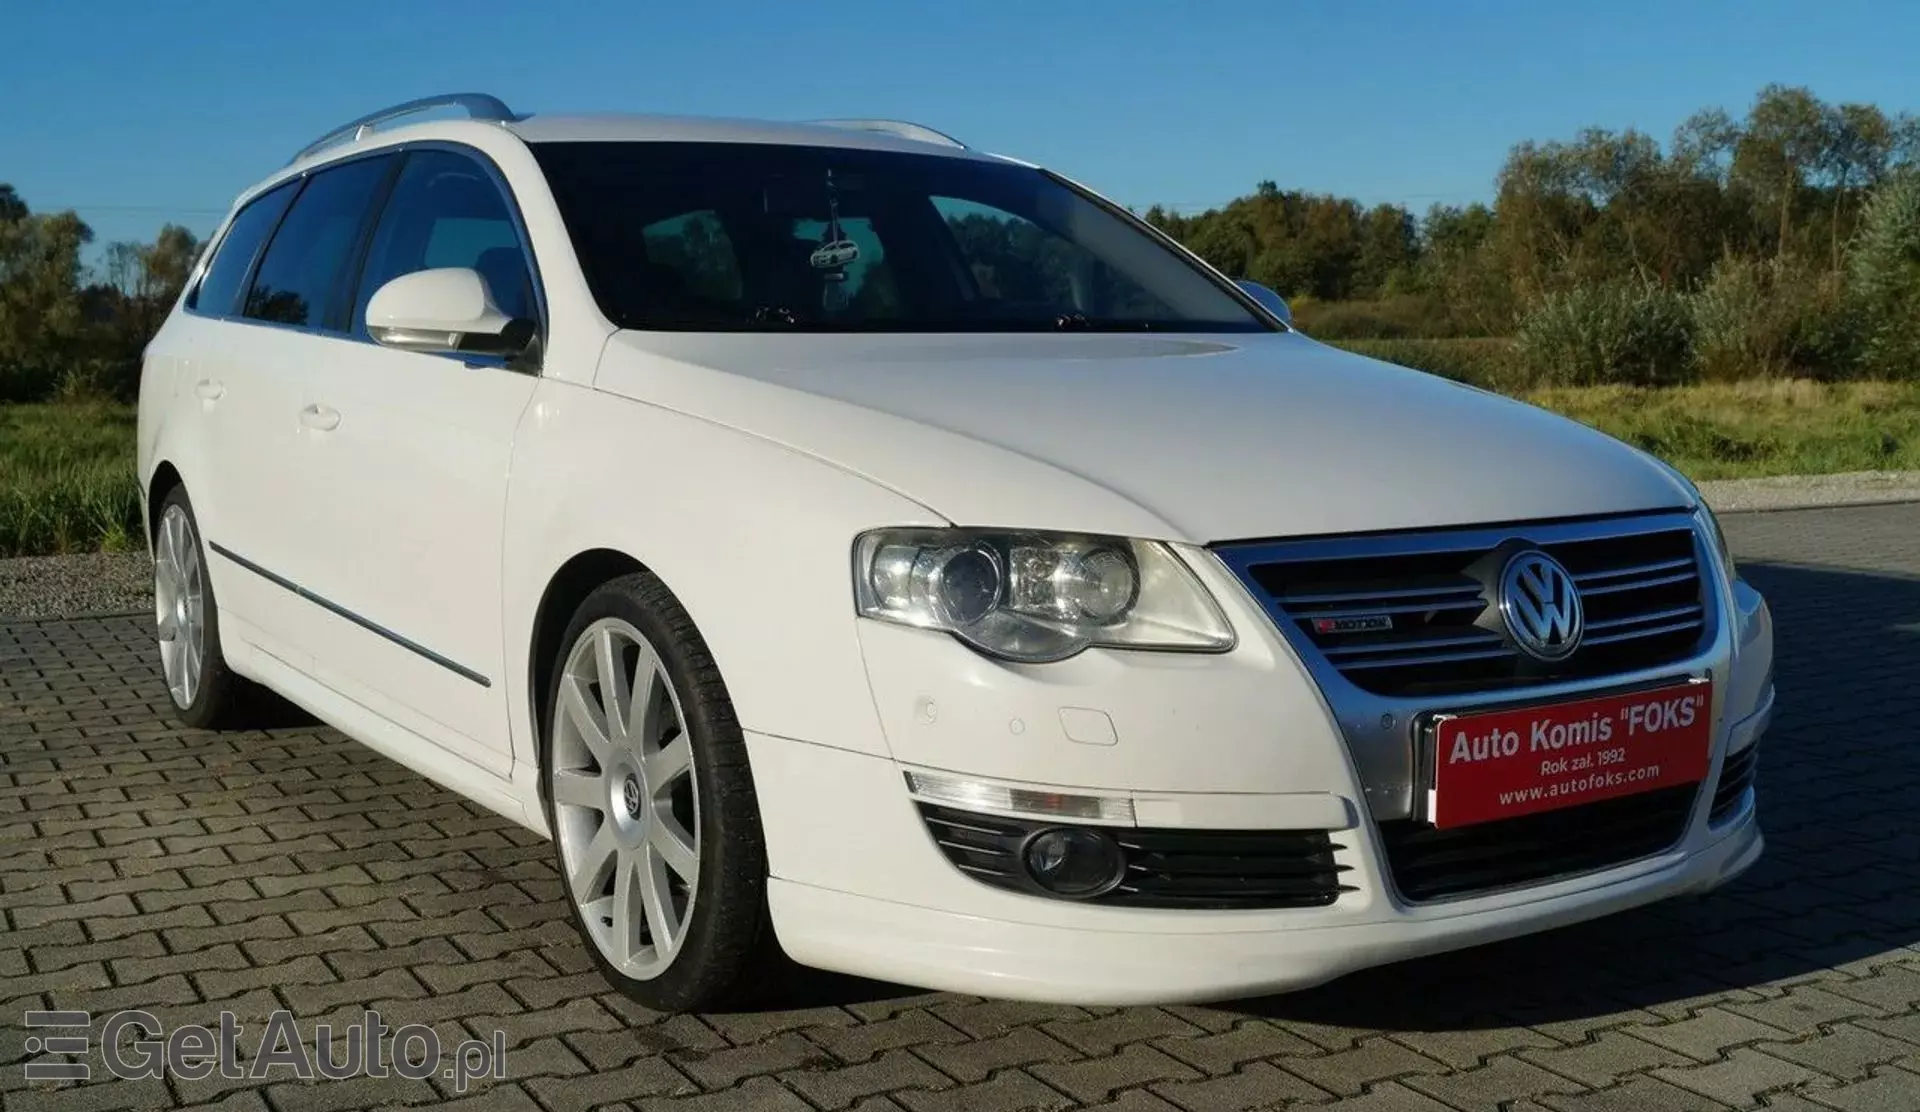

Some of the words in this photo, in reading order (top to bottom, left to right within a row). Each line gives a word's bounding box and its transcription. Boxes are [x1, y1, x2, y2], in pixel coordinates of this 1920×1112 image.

[1503, 560, 1579, 650] VW
[1450, 731, 1519, 764] Auto
[1530, 712, 1613, 752] Komis
[1620, 695, 1704, 735] "FOKS"
[1499, 765, 1659, 805] www.autofoks.com
[1541, 758, 1568, 776] Rok
[1597, 748, 1626, 766] 1992
